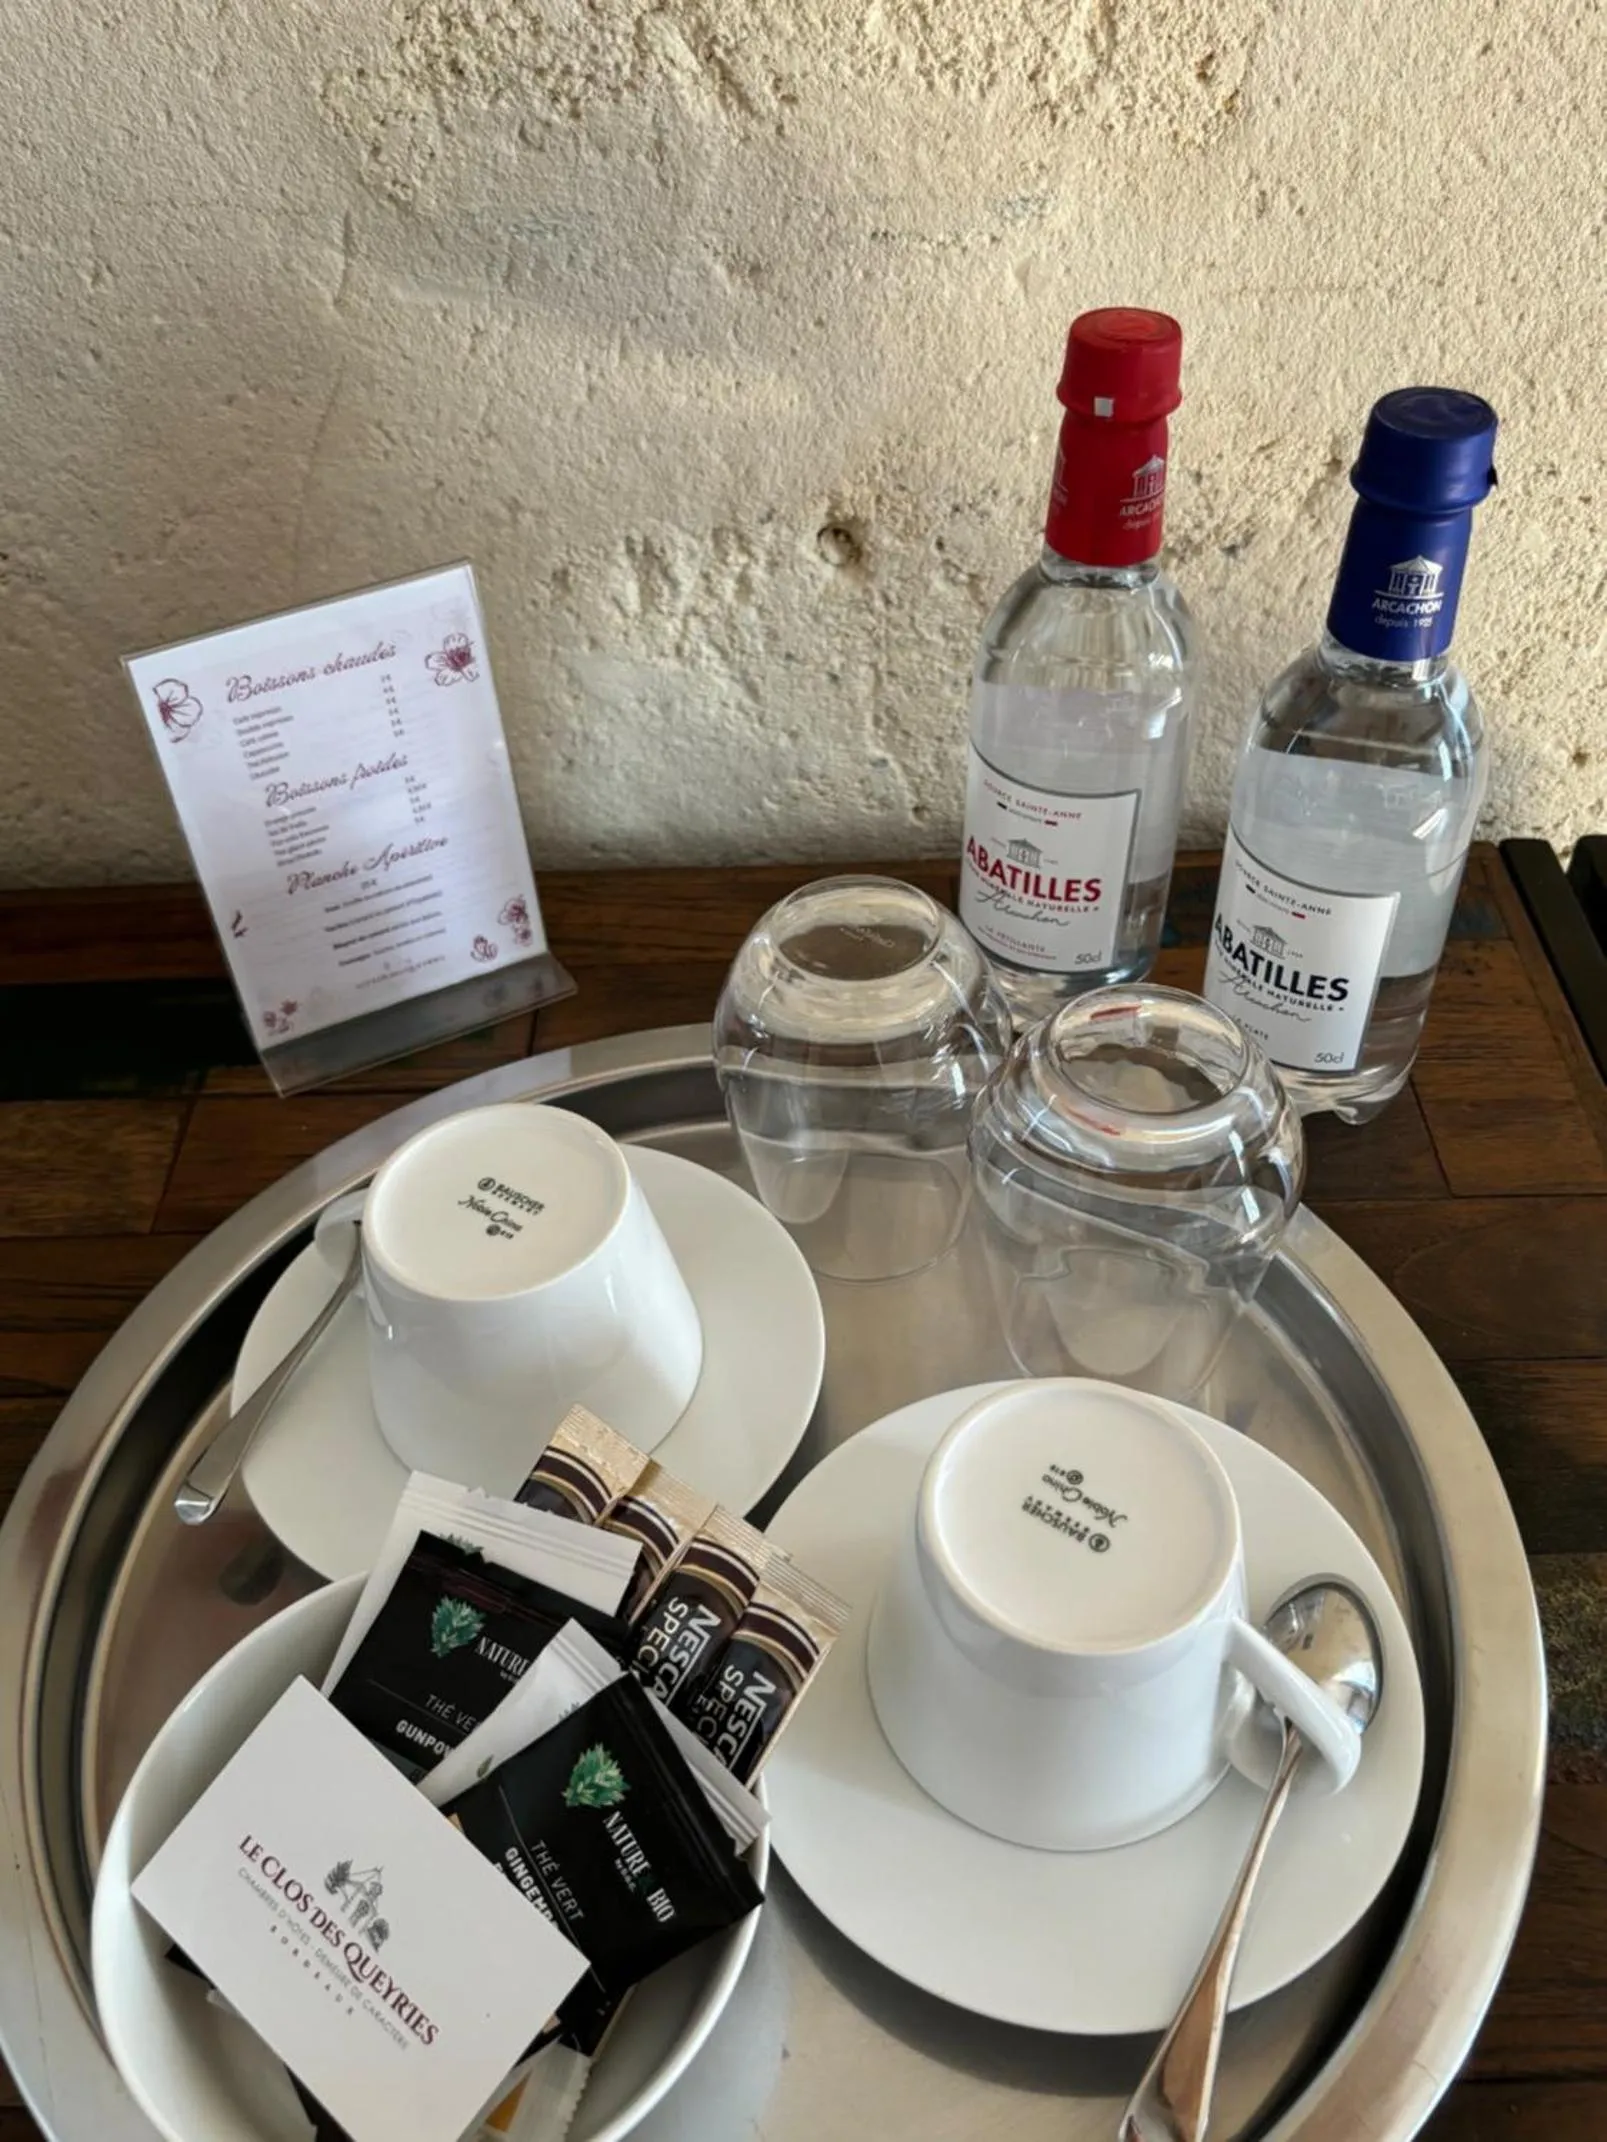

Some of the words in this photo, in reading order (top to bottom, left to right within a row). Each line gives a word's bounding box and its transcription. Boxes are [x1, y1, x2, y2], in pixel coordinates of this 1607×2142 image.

[1371, 598, 1443, 615] ARCACHON
[225, 667, 316, 703] Boissons
[322, 641, 397, 676] chaudes
[265, 772, 348, 807] Boissons
[349, 752, 409, 791] froides
[286, 861, 359, 895] Planche
[966, 835, 1102, 902] ABATILLES
[1263, 884, 1332, 916] SAINTE-ANNE
[1074, 949, 1102, 966] 50cl
[1214, 913, 1350, 1001] ABATILLES
[1314, 1051, 1345, 1065] 50cl
[1021, 1502, 1087, 1543] BAUSCHER
[425, 1694, 455, 1718] THÉ
[456, 1711, 481, 1732] VE
[238, 1866, 279, 1911] CHAMBRES
[531, 1840, 560, 1877] THÉ
[551, 1876, 584, 1921] VERT
[603, 1810, 651, 1877] NATURE
[646, 1887, 677, 1923] BIO
[239, 1834, 264, 1862] LE
[260, 1856, 314, 1912] CLOS
[309, 1906, 345, 1947] DES
[343, 1942, 440, 2045] QUEYRIES
